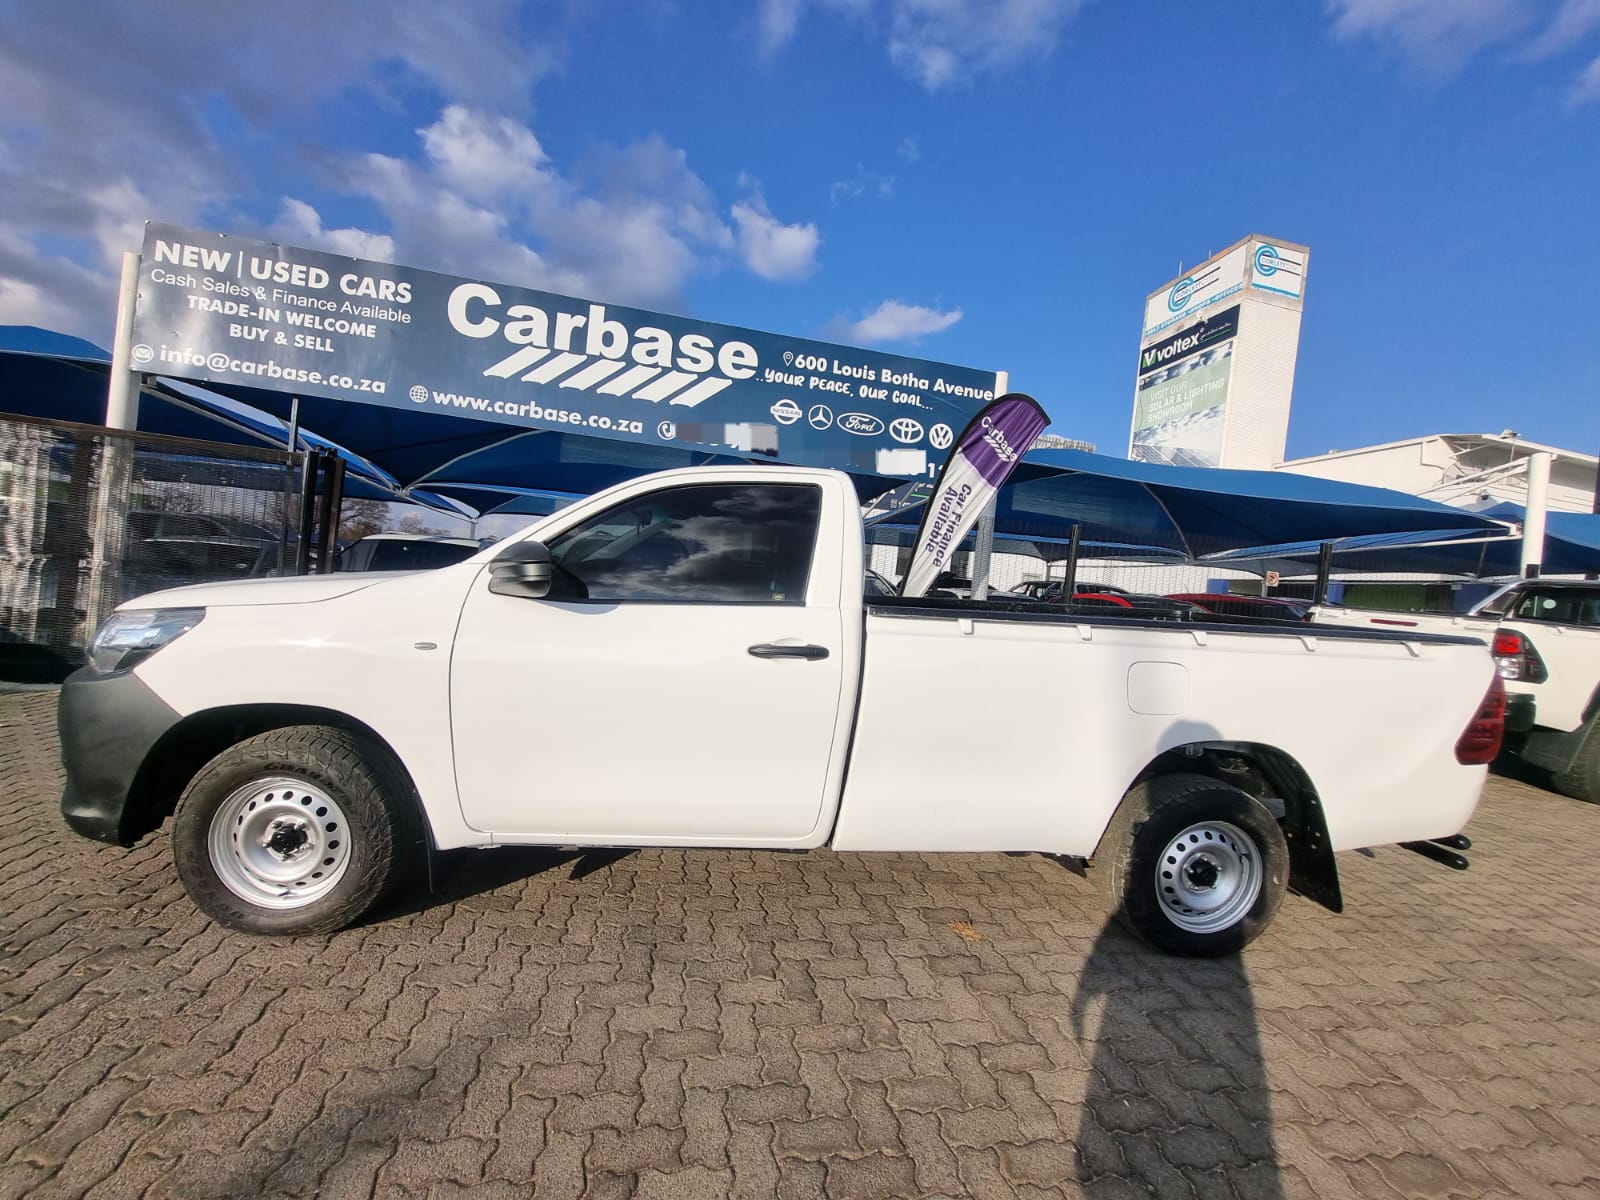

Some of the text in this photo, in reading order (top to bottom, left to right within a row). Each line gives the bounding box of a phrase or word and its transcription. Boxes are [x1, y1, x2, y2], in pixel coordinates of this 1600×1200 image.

[154, 240, 412, 304] NEW USED CARS
[151, 269, 411, 323] Cash Sales & Finance Available
[187, 295, 376, 338] TRADE-IN WELCOME
[229, 324, 334, 352] BUY & SELL
[447, 282, 758, 379] Carbase
[1157, 332, 1200, 362] voltex
[159, 344, 386, 394] info@carbase.co.za
[794, 353, 994, 401] 600 Louis Botha Avenue
[809, 377, 854, 397] PEACE,
[859, 384, 888, 401] OUR
[432, 391, 643, 434] www.carbase.co.za
[1147, 399, 1193, 423] SHOWROOM
[1149, 395, 1174, 412] SOLAR
[1184, 378, 1225, 401] LIGHTING
[1150, 381, 1187, 401] VISIT OUR
[845, 414, 875, 432] Ford
[981, 416, 1018, 462] Carbase
[925, 486, 958, 553] Available
[932, 483, 972, 568] Car Finance
